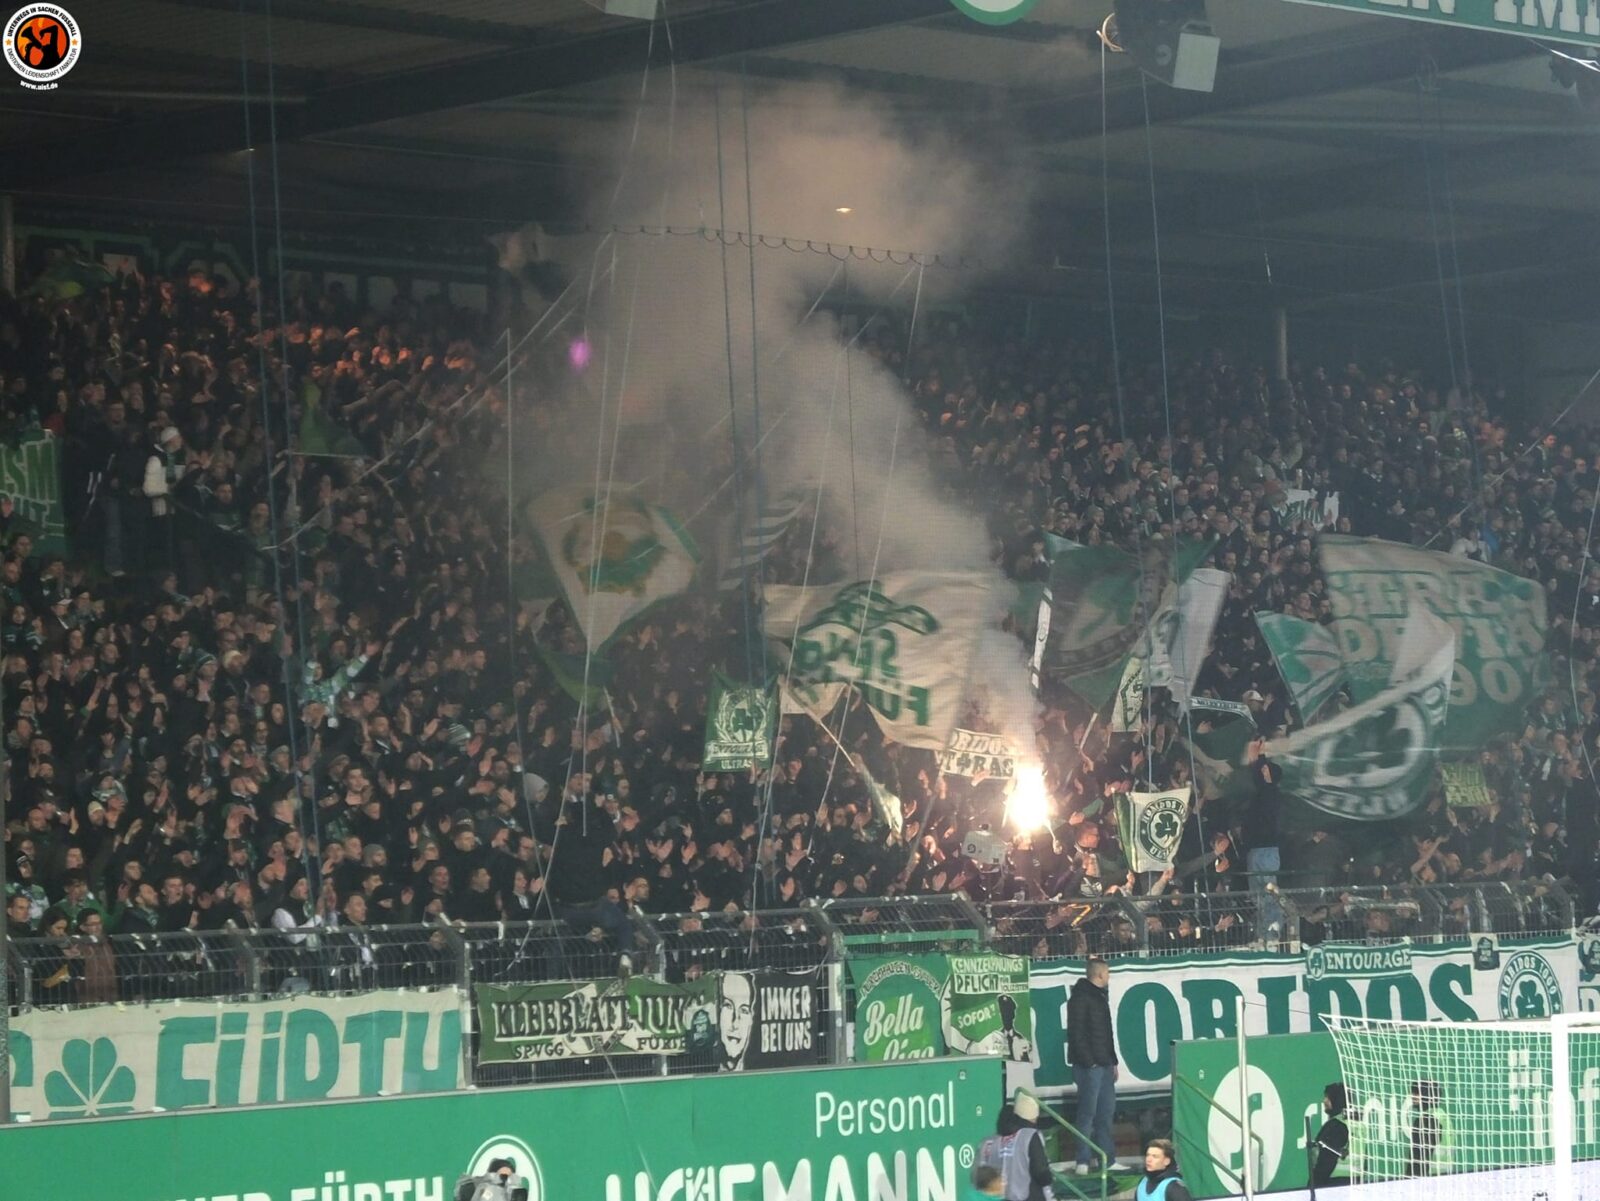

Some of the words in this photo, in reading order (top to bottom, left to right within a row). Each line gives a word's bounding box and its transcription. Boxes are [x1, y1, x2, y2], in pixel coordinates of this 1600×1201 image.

[1325, 949, 1411, 971] ENTOURAGE
[1501, 955, 1536, 997] HORIDOS
[956, 973, 998, 993] PFLICHT
[760, 985, 811, 1021] IMMER
[863, 993, 924, 1046] Bella
[761, 1022, 781, 1053] BEI
[785, 1021, 811, 1051] UNS
[815, 1080, 954, 1138] Personal
